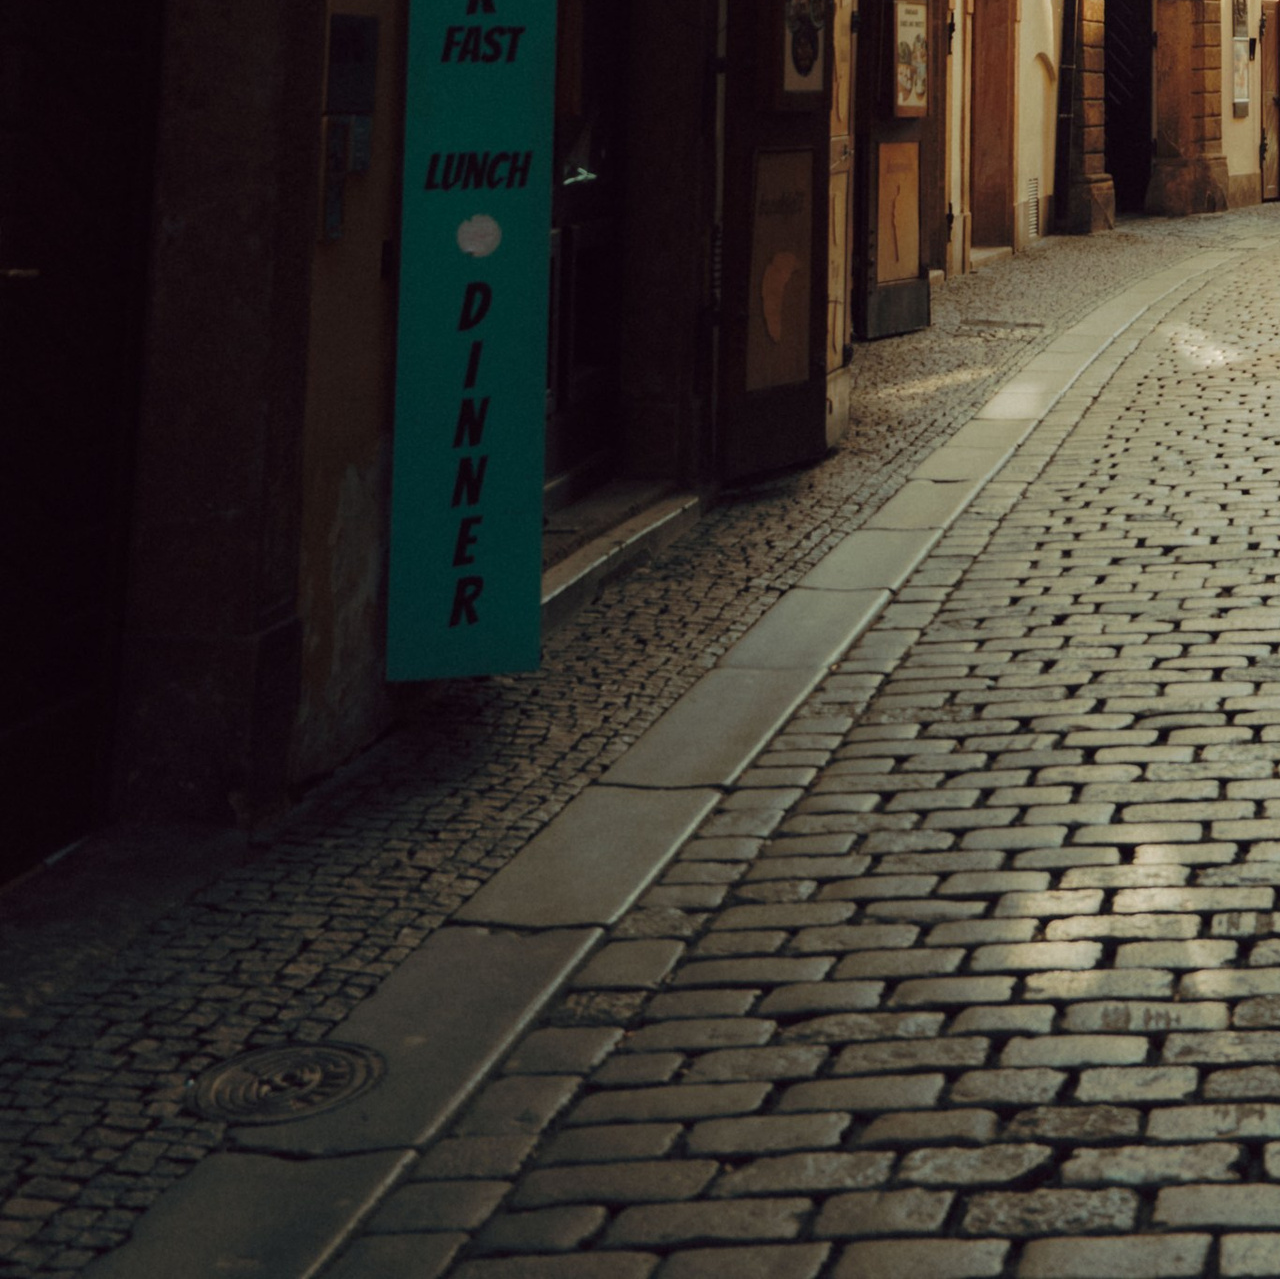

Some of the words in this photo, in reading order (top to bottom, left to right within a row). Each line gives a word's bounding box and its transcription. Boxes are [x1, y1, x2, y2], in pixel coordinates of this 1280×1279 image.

[440, 25, 526, 64] FAST
[424, 151, 533, 191] LUNCH
[448, 281, 493, 628] DINNER
